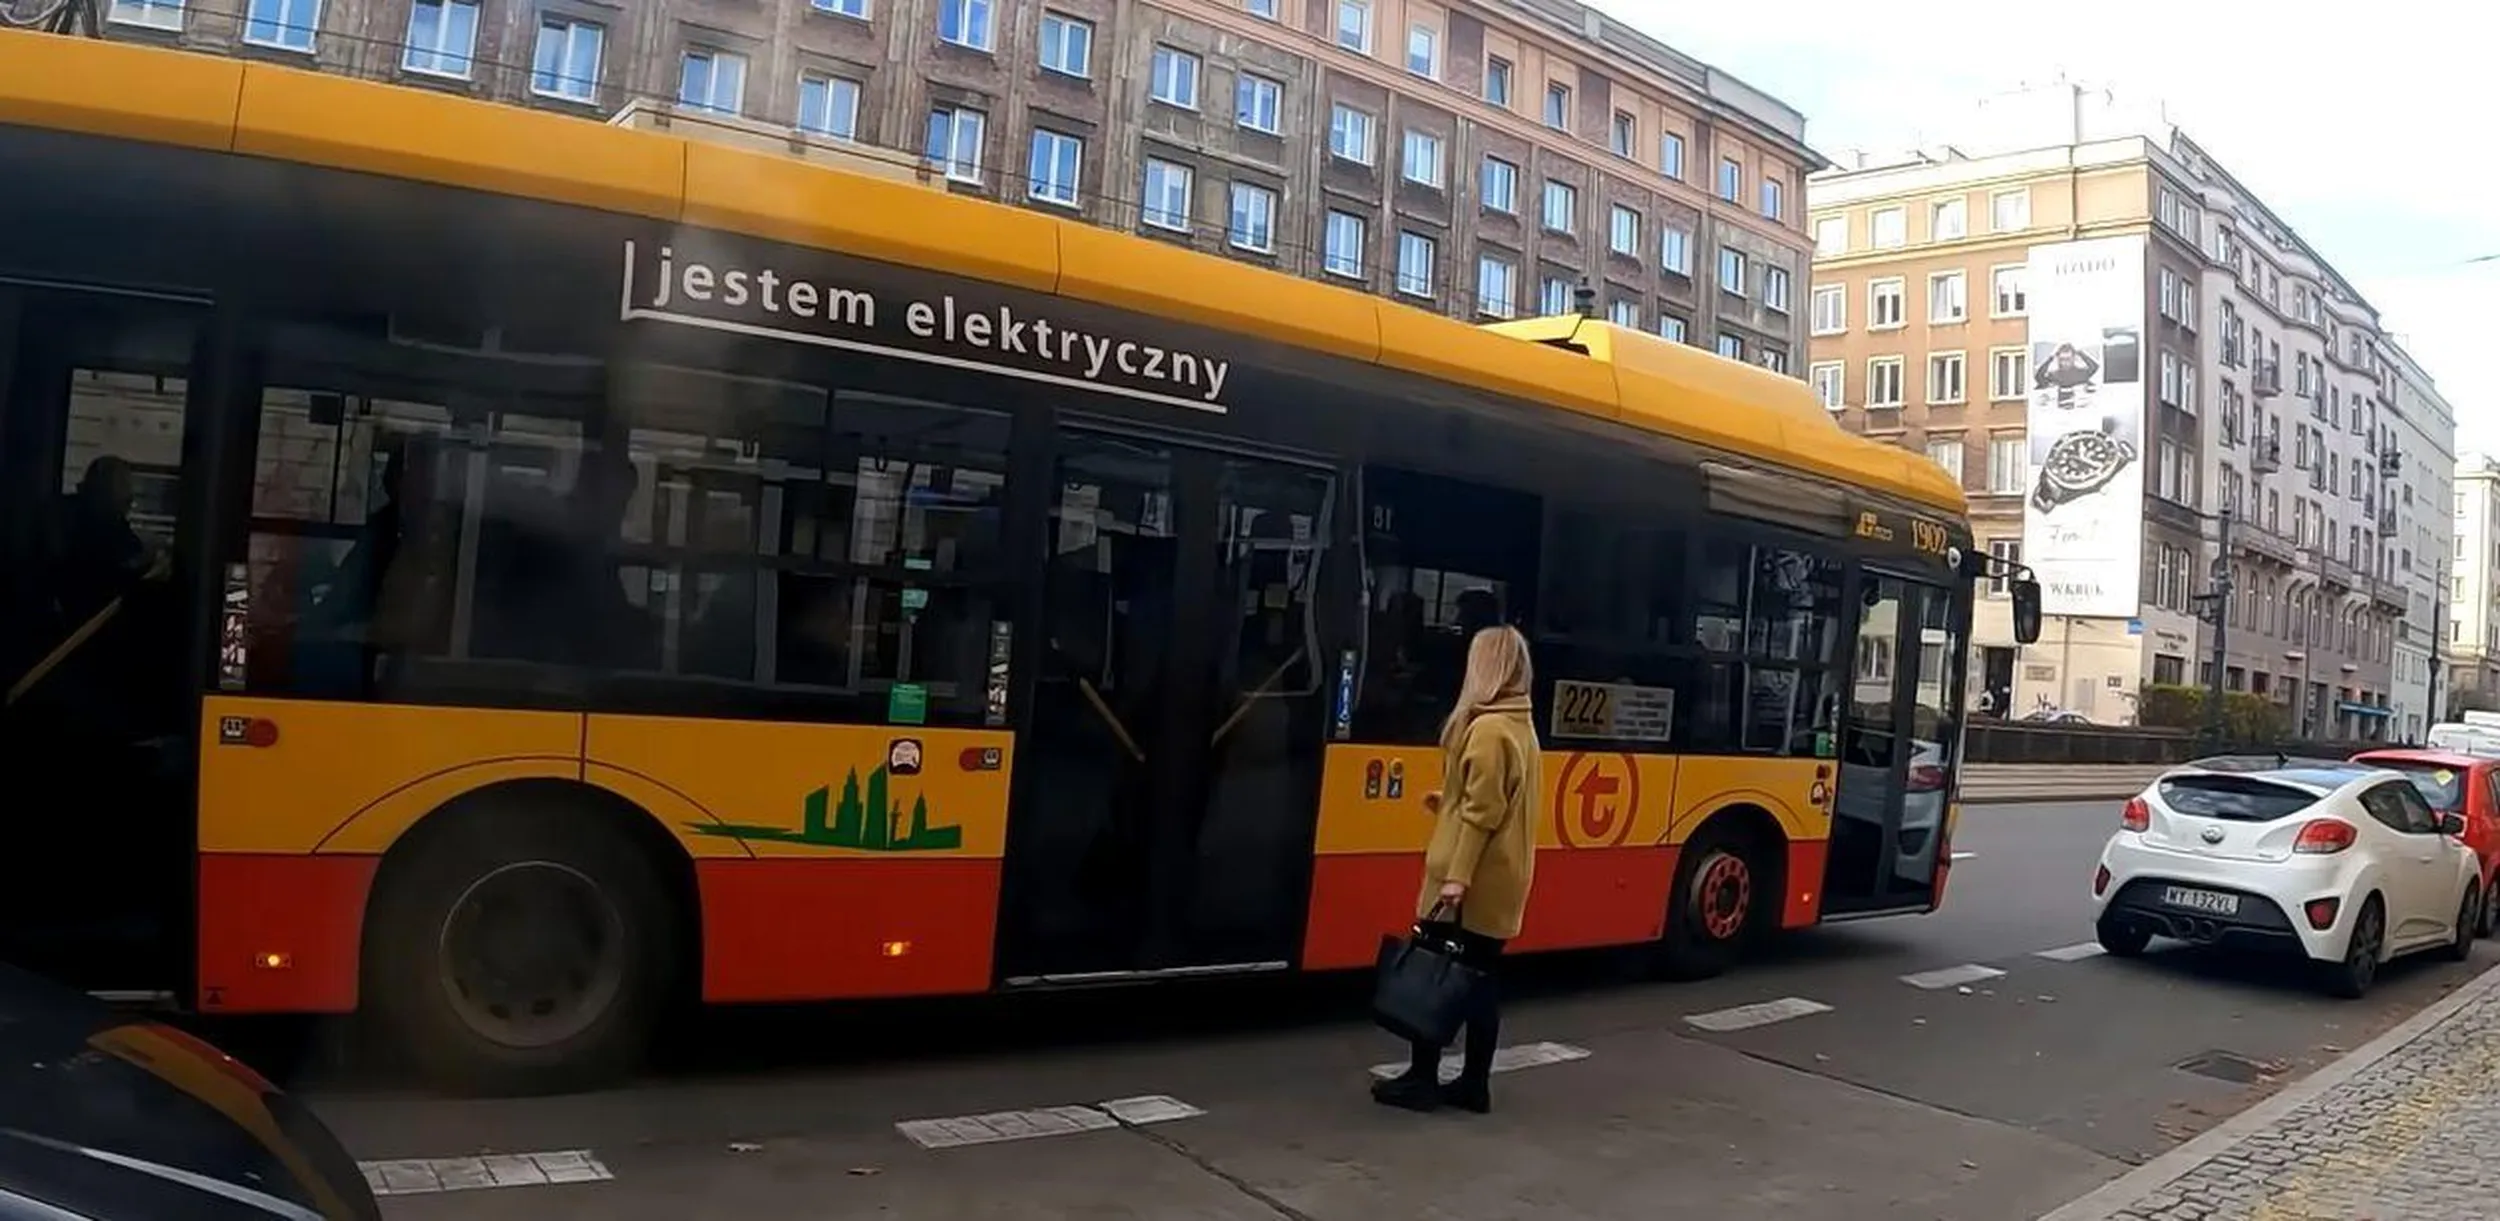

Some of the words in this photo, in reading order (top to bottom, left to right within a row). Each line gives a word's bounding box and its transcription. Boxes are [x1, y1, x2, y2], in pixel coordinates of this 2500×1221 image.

[653, 246, 876, 328] jestem
[905, 296, 1229, 399] elektryczny
[1911, 519, 1948, 555] 1902
[1562, 685, 1607, 725] 222
